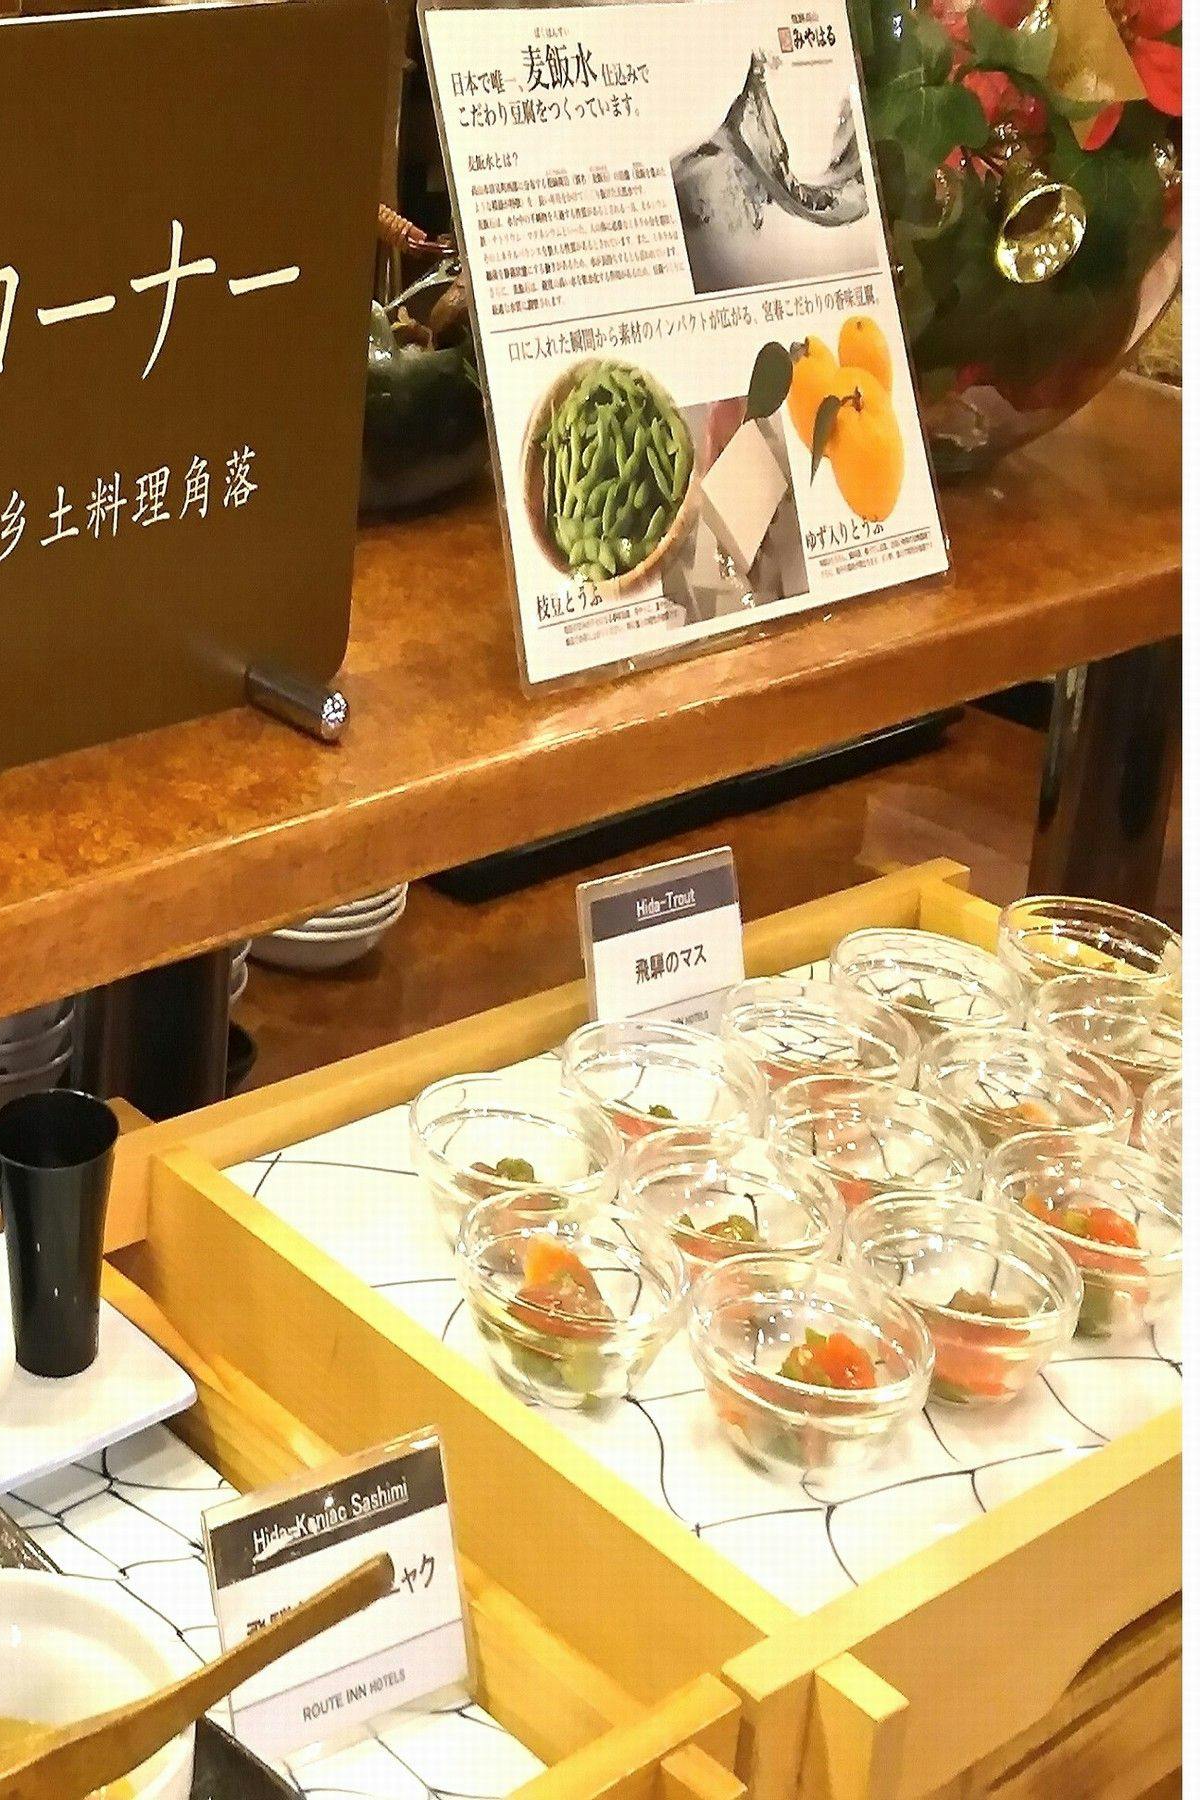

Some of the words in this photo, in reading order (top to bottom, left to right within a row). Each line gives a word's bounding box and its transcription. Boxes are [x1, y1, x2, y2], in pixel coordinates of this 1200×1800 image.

[792, 24, 836, 50] みやはる
[636, 887, 697, 918] Hida-Trout
[351, 1475, 409, 1516] Sashimi
[302, 1692, 344, 1723] ROUTE
[346, 1684, 368, 1705] INN
[369, 1668, 406, 1694] HOTELS
